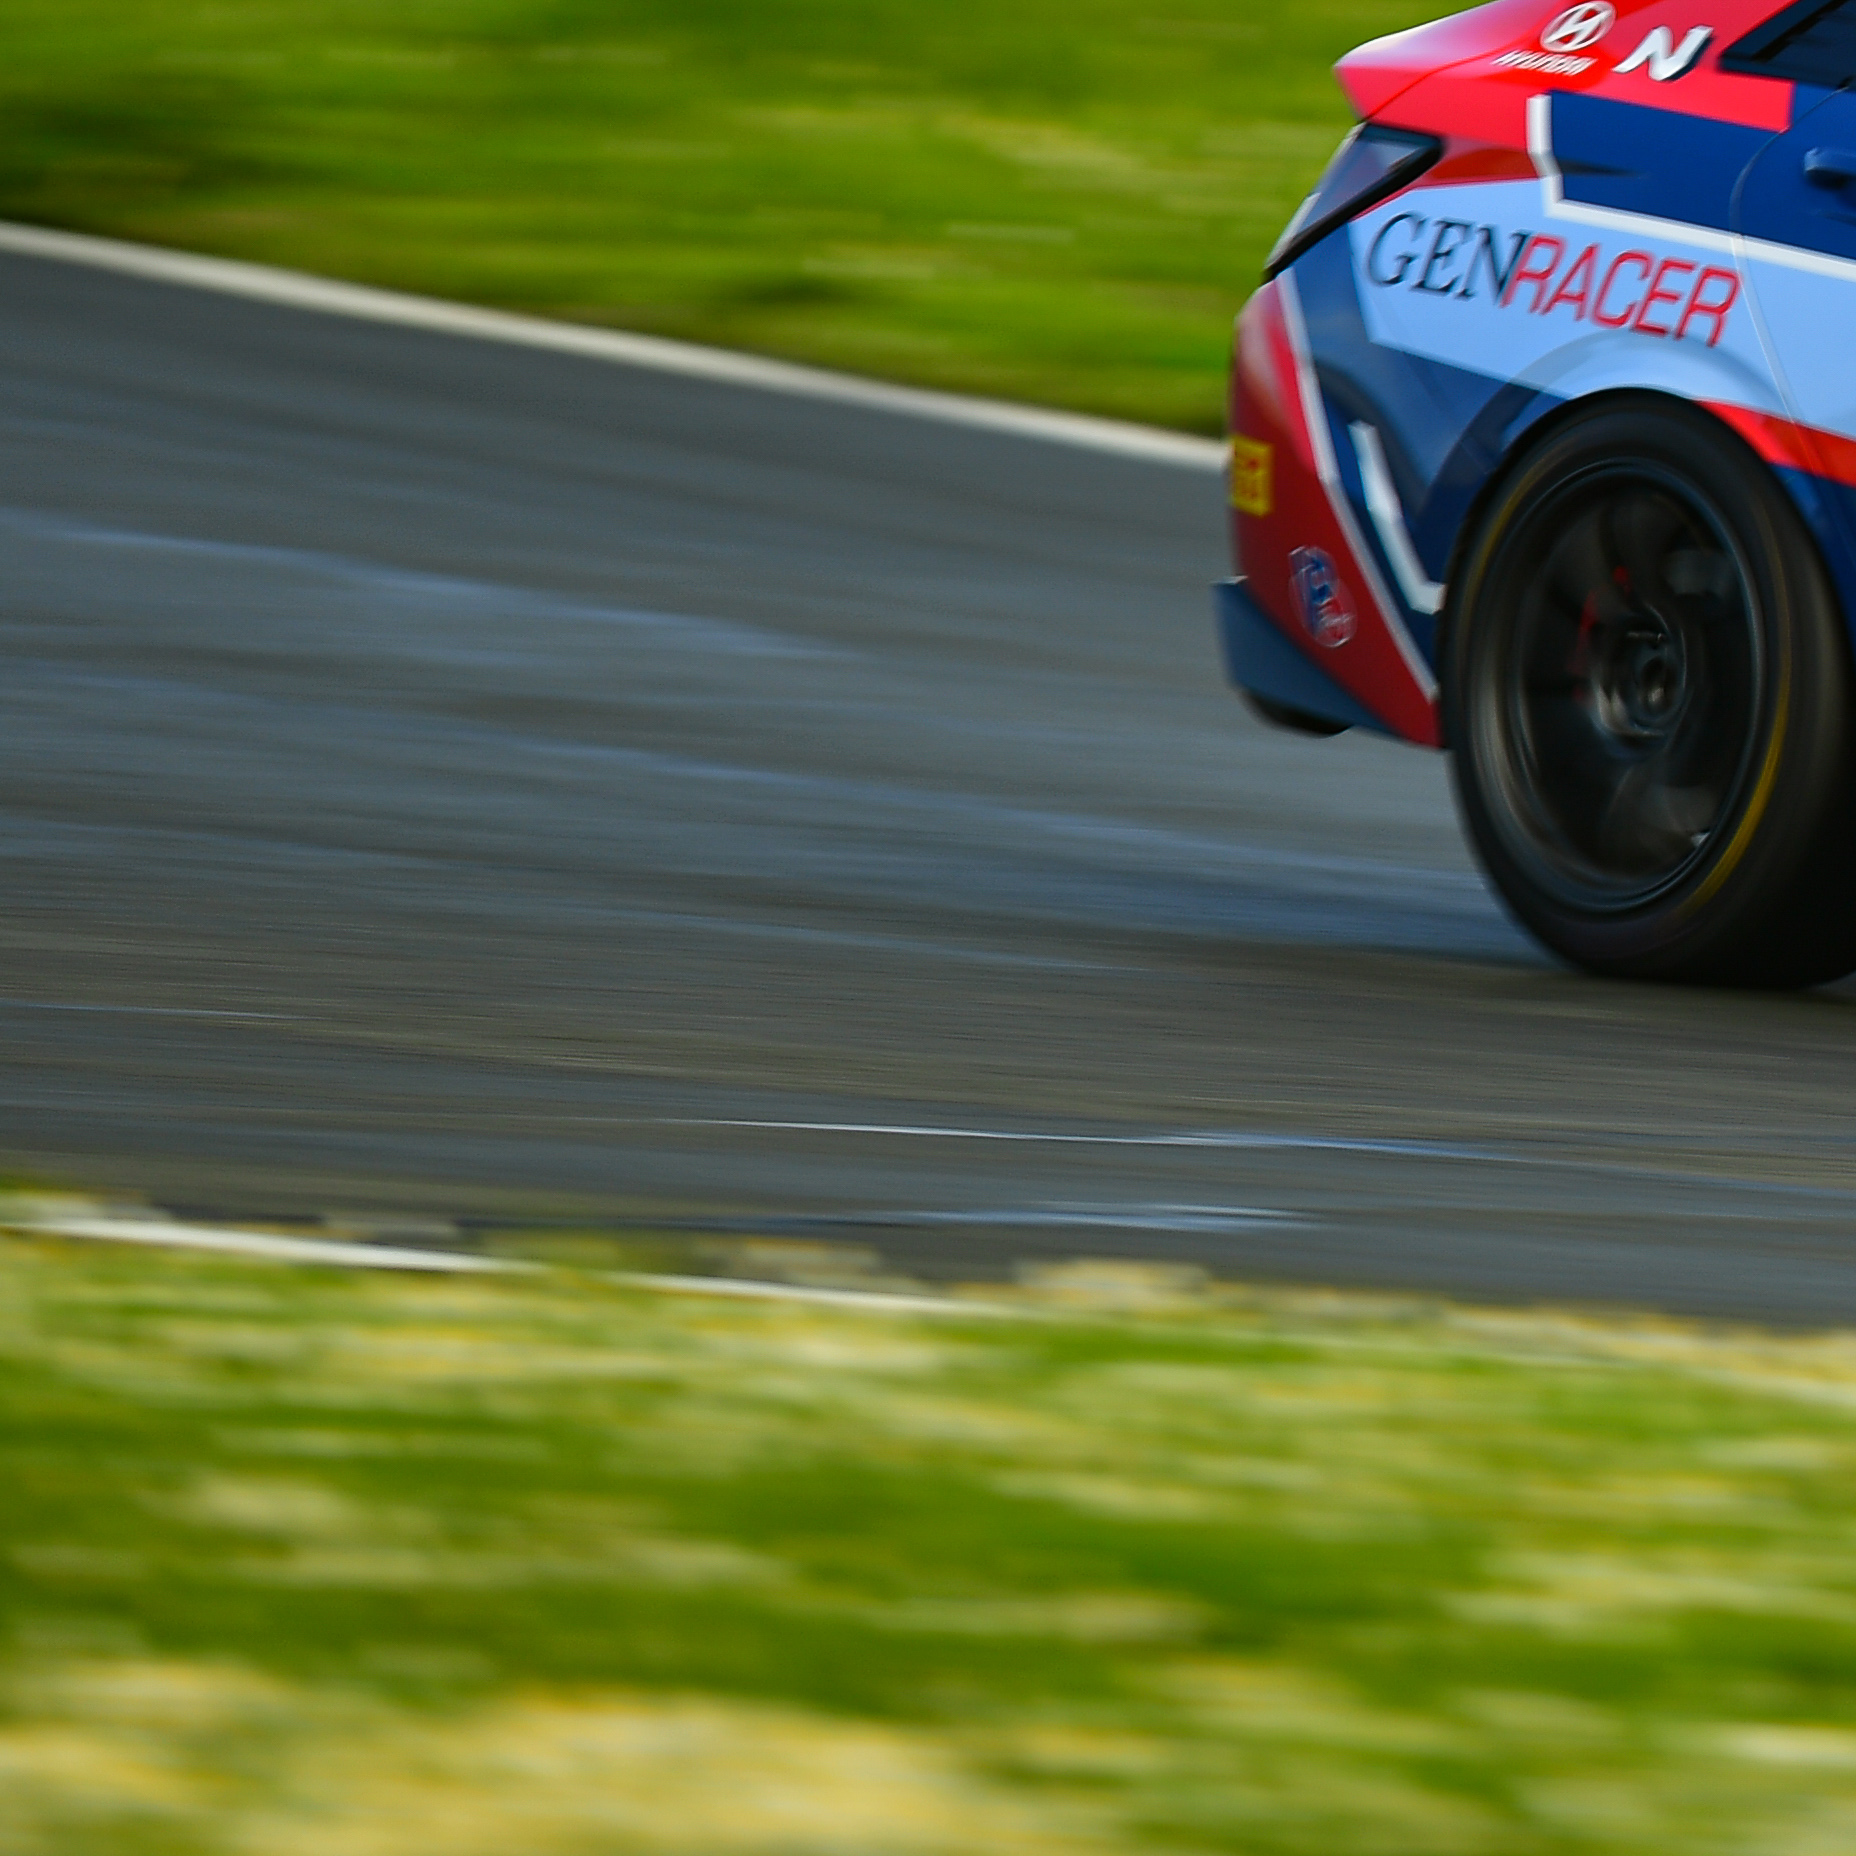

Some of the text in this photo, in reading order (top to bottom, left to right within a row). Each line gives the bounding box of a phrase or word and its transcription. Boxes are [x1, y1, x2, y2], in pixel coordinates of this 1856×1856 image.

[1490, 49, 1598, 76] HYUNDAI
[1612, 25, 1714, 81] N
[1367, 211, 1743, 347] GENRACER
